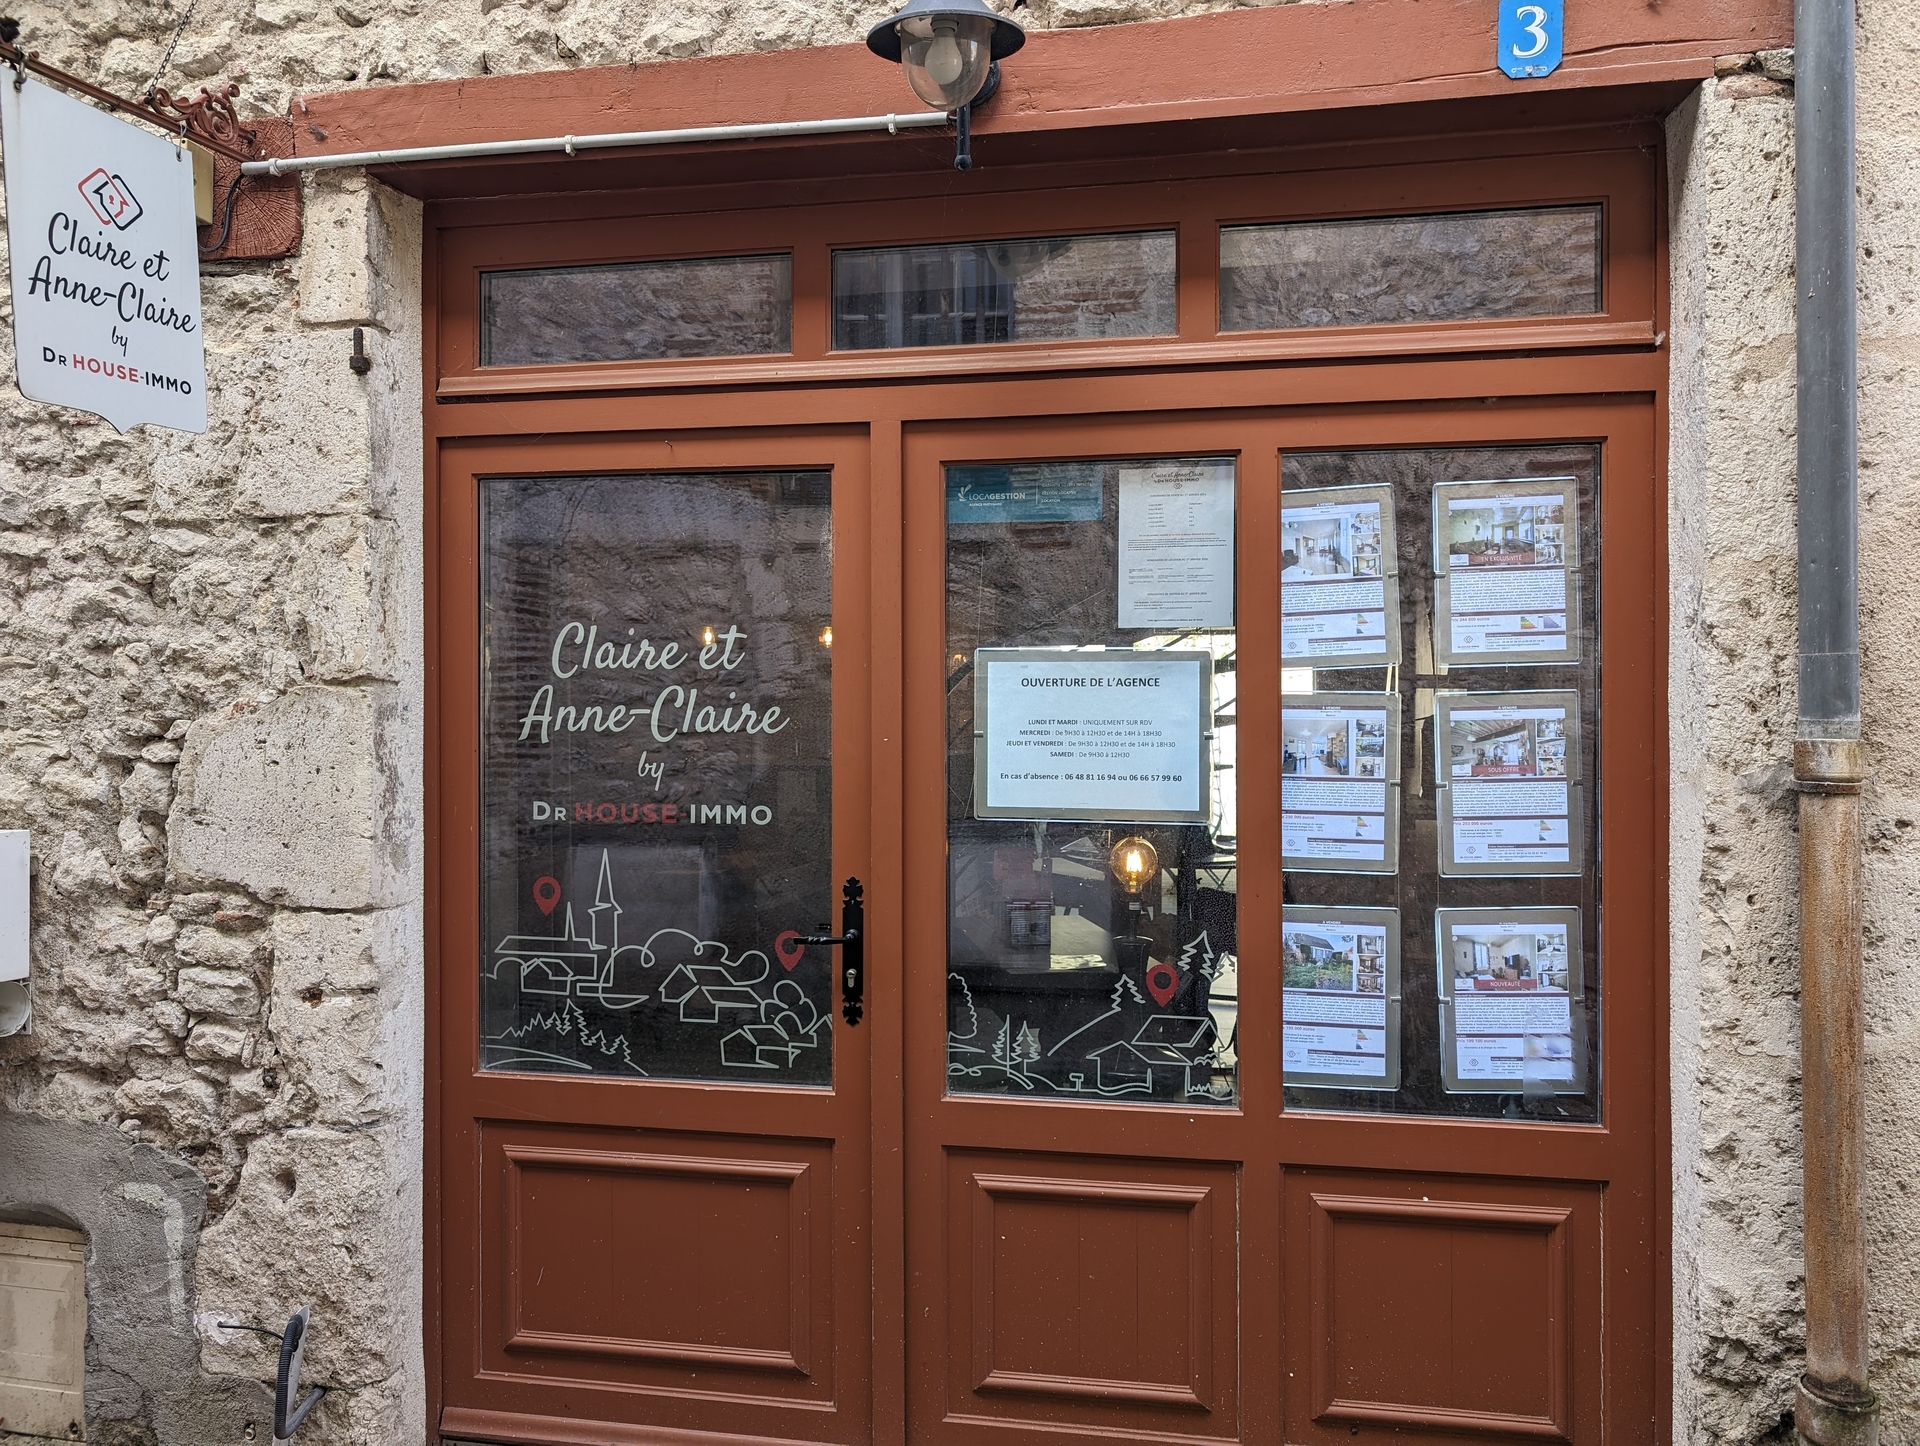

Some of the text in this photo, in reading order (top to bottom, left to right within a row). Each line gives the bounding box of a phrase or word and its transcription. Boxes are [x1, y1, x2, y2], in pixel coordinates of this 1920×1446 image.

[1512, 5, 1549, 59] 3
[48, 212, 170, 281] Claire et
[28, 255, 197, 333] Anne-Claire
[111, 325, 128, 357] by
[72, 353, 192, 395] HOUSE-IMMO
[968, 492, 1026, 501] LOCAGESTION
[551, 621, 748, 679] Claire et
[1021, 677, 1161, 688] OUVERTURE DE L’AGENCE
[518, 684, 790, 744] Anne-Claire
[637, 750, 665, 791] by
[1023, 772, 1059, 780] d’absence
[1161, 774, 1171, 782] 99
[1172, 774, 1182, 782] 60
[575, 802, 772, 825] HOUSE-IMMO
